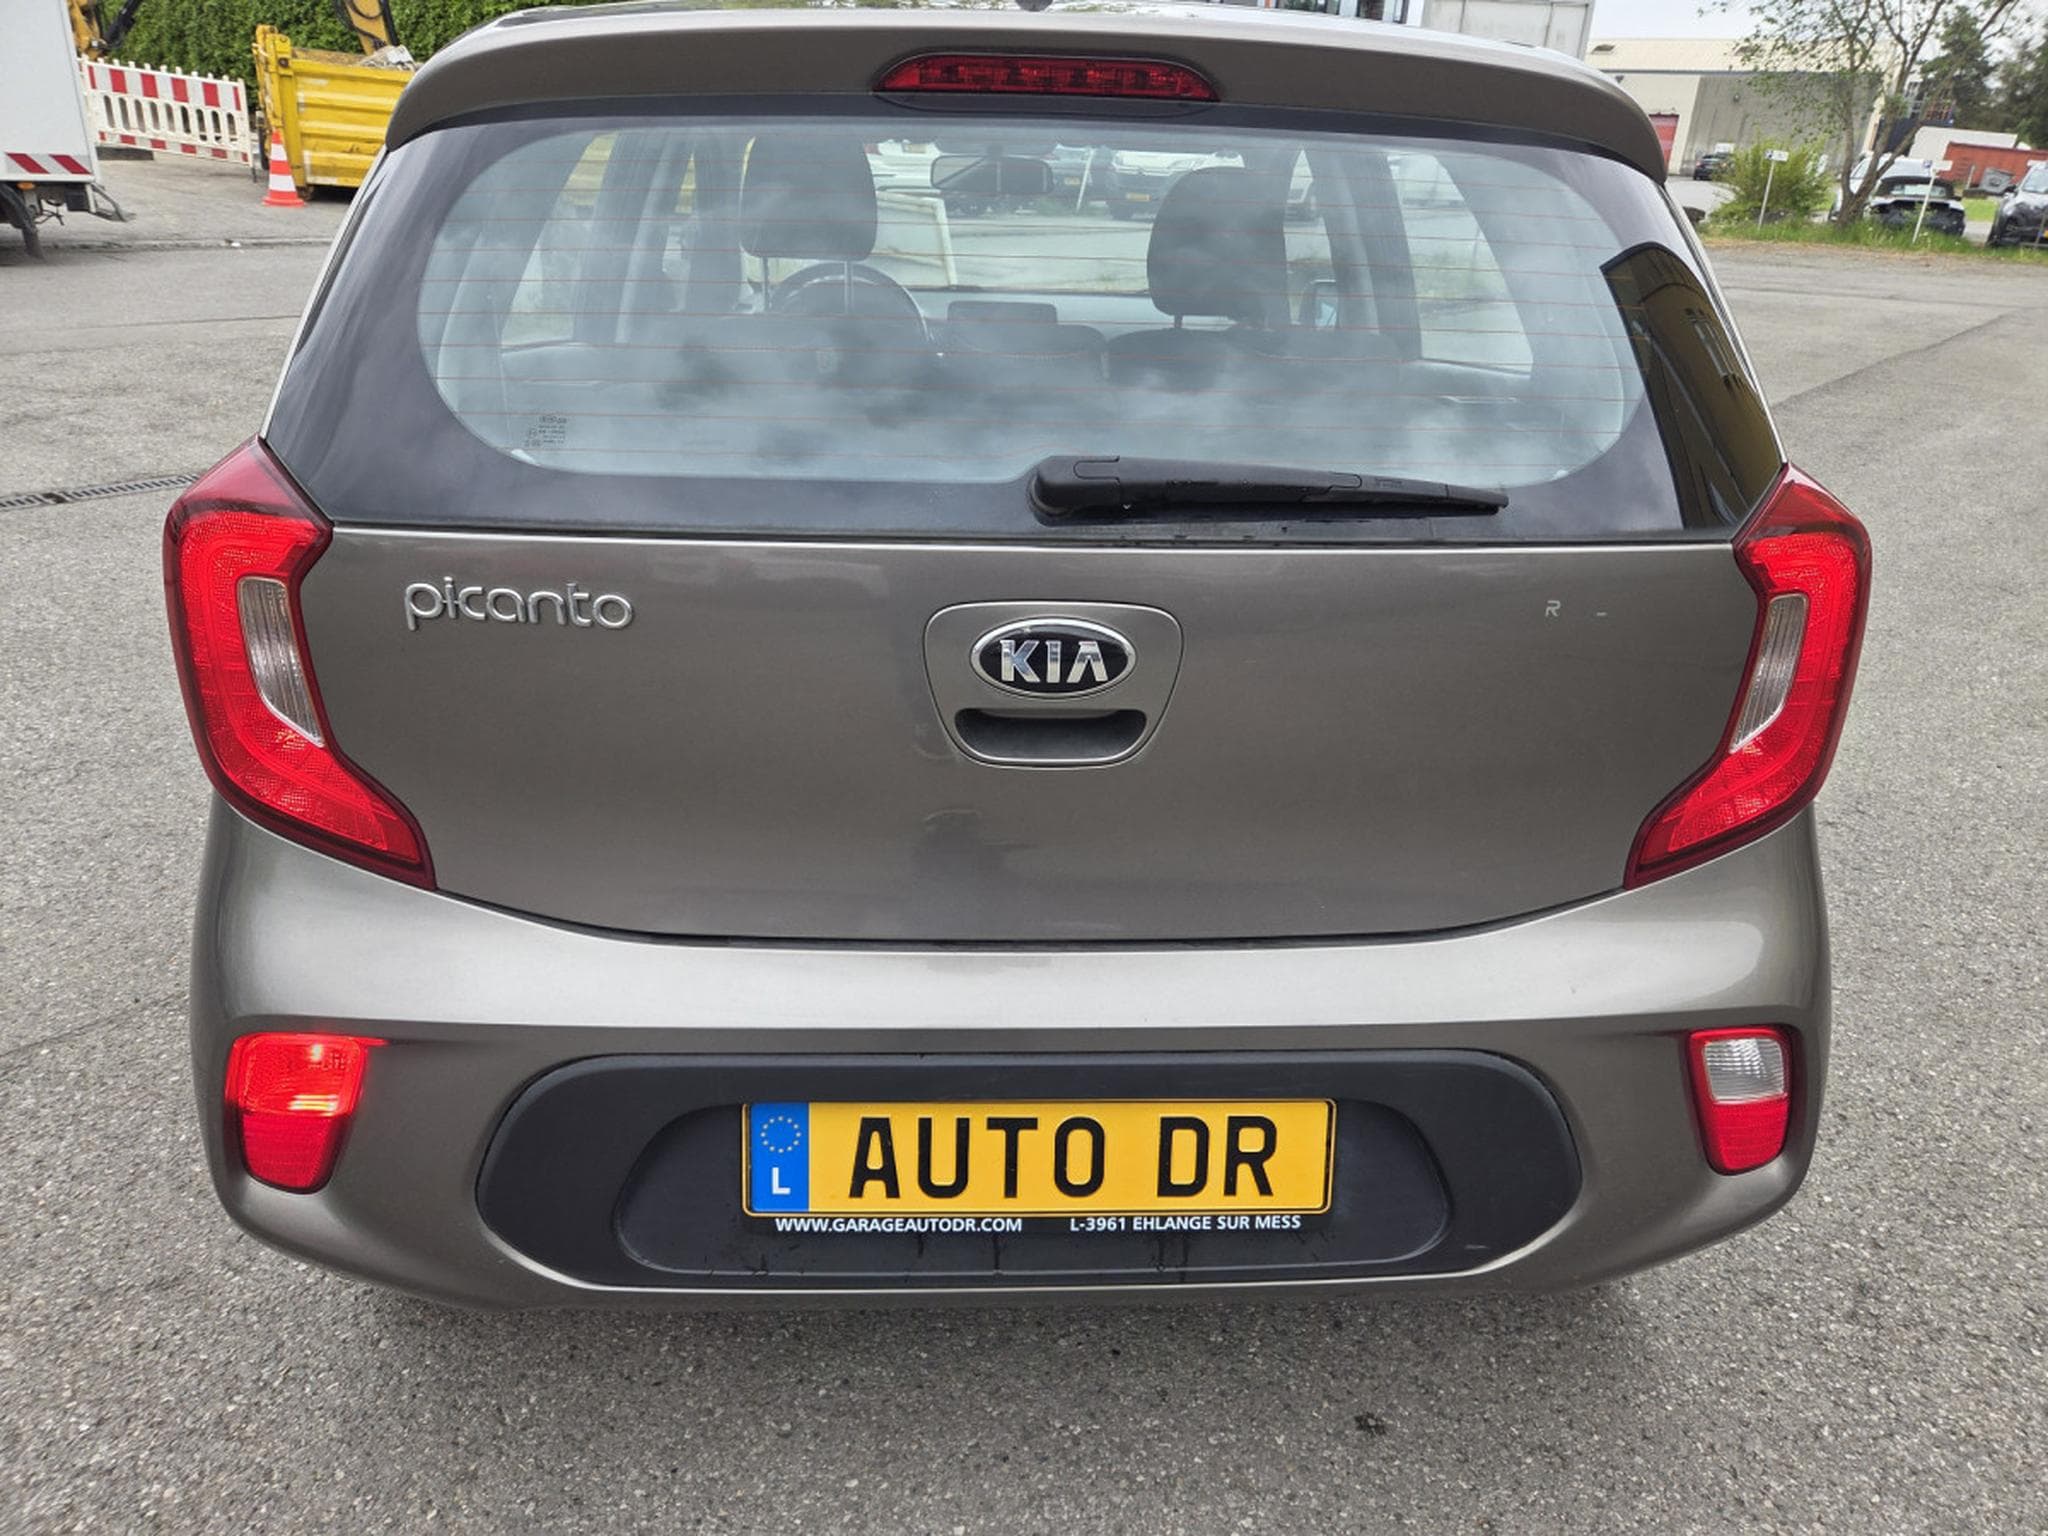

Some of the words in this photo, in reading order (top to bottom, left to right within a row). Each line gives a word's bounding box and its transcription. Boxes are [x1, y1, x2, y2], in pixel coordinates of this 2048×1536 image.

[404, 576, 633, 631] picanto
[1000, 639, 1109, 683] KIA
[848, 1116, 1105, 1199] AUTO
[1157, 1115, 1277, 1198] DR
[772, 1167, 791, 1194] L
[775, 1218, 1023, 1233] WWW.GARAGEAUTODR.COM
[1070, 1217, 1126, 1232] L-3961
[1133, 1216, 1212, 1231] EHLANGE
[1217, 1215, 1250, 1230] SUR
[1255, 1215, 1301, 1229] MESS
